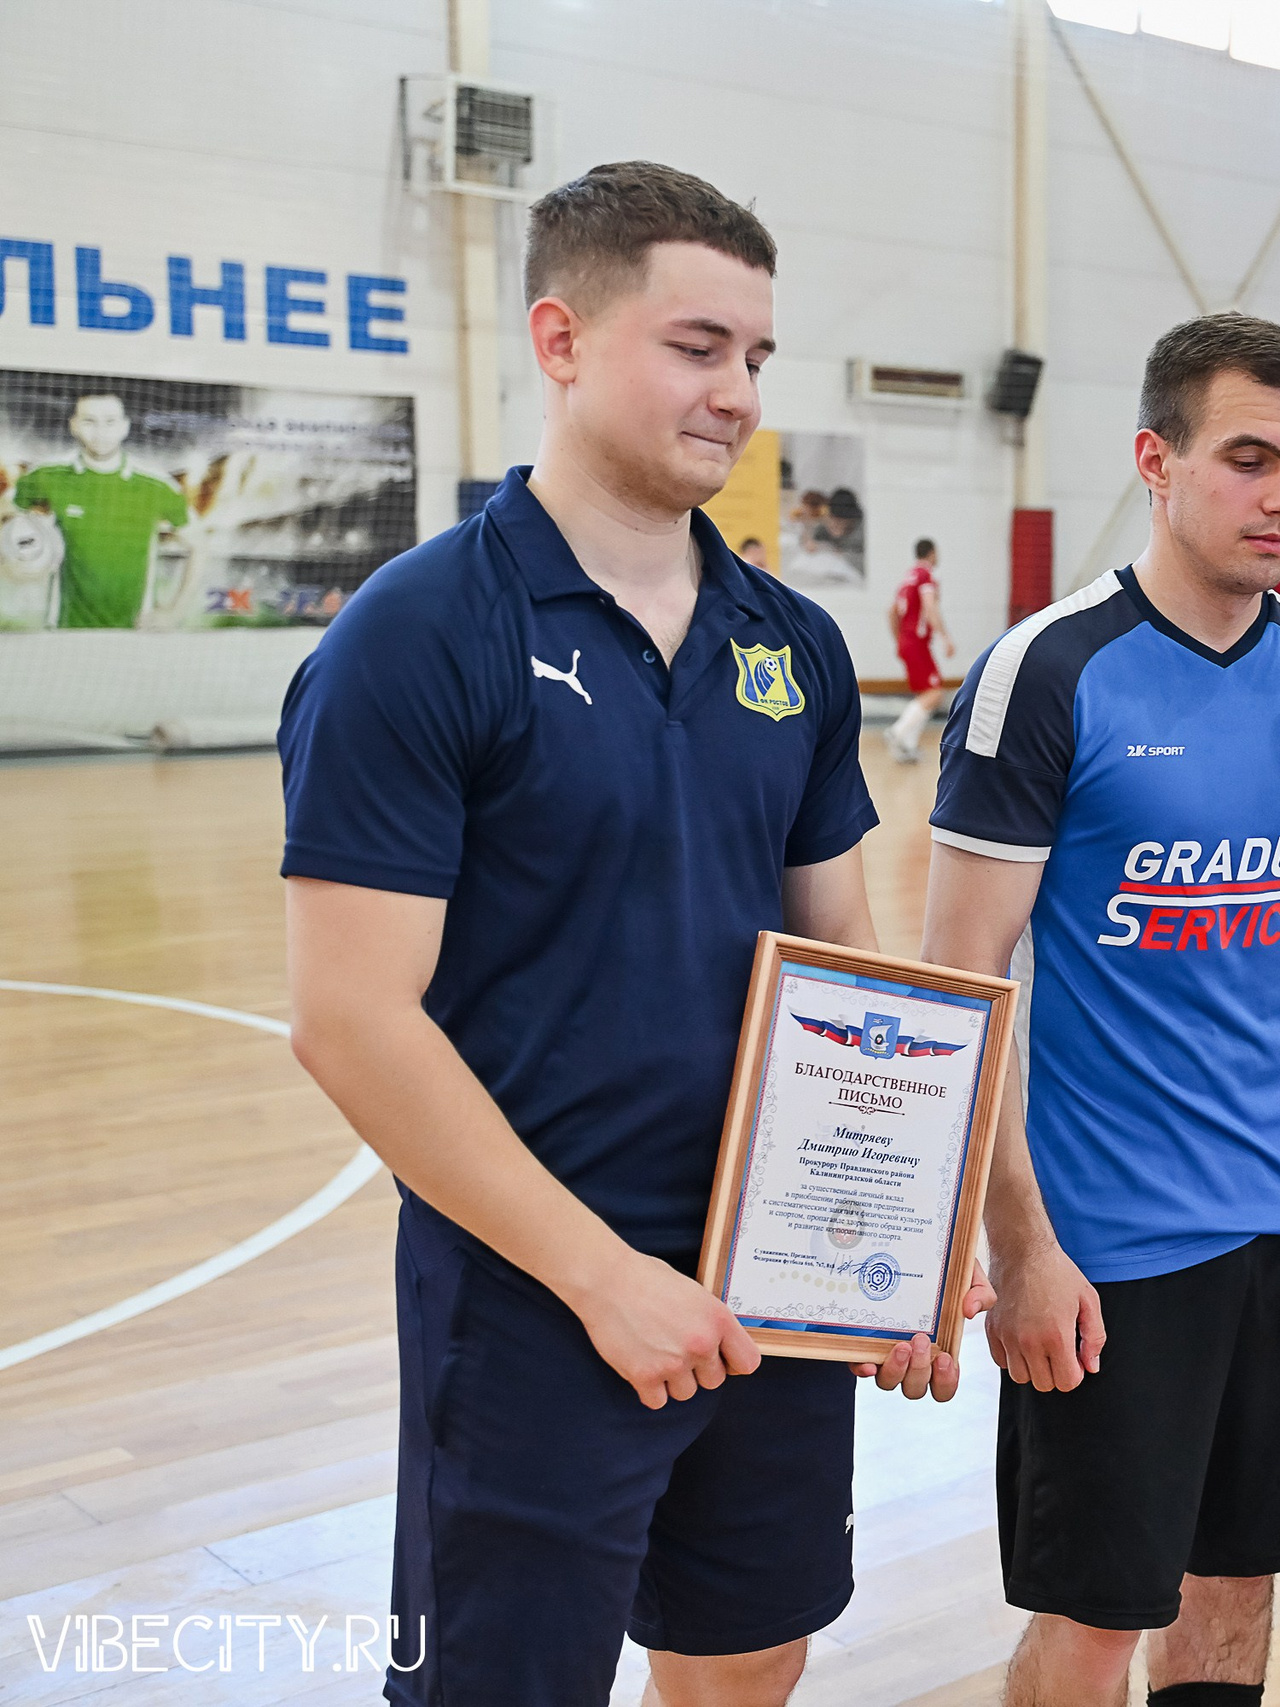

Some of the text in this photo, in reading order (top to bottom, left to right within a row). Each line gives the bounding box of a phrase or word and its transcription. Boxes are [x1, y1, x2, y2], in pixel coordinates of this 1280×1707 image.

[0, 238, 408, 354] ЛЬНЕЕ
[1127, 745, 1185, 756] 2K SPORT
[794, 1062, 947, 1098] БЛАГОДАРСТВЕННОЕ
[838, 1088, 902, 1109] ПИСЬМО
[833, 1126, 893, 1147] Митряеву
[797, 1138, 920, 1168] Дмитрию Игоревичу
[799, 1157, 838, 1170] Прокурору
[890, 1171, 915, 1179] района
[810, 1168, 902, 1187] Калининградской области
[808, 1184, 857, 1197] существенный
[858, 1191, 884, 1200] личный
[768, 1200, 828, 1212] систематическим
[860, 1210, 898, 1221] физической
[900, 1216, 933, 1226] культурой
[791, 1193, 834, 1203] приобщении
[873, 1203, 915, 1213] предприятия
